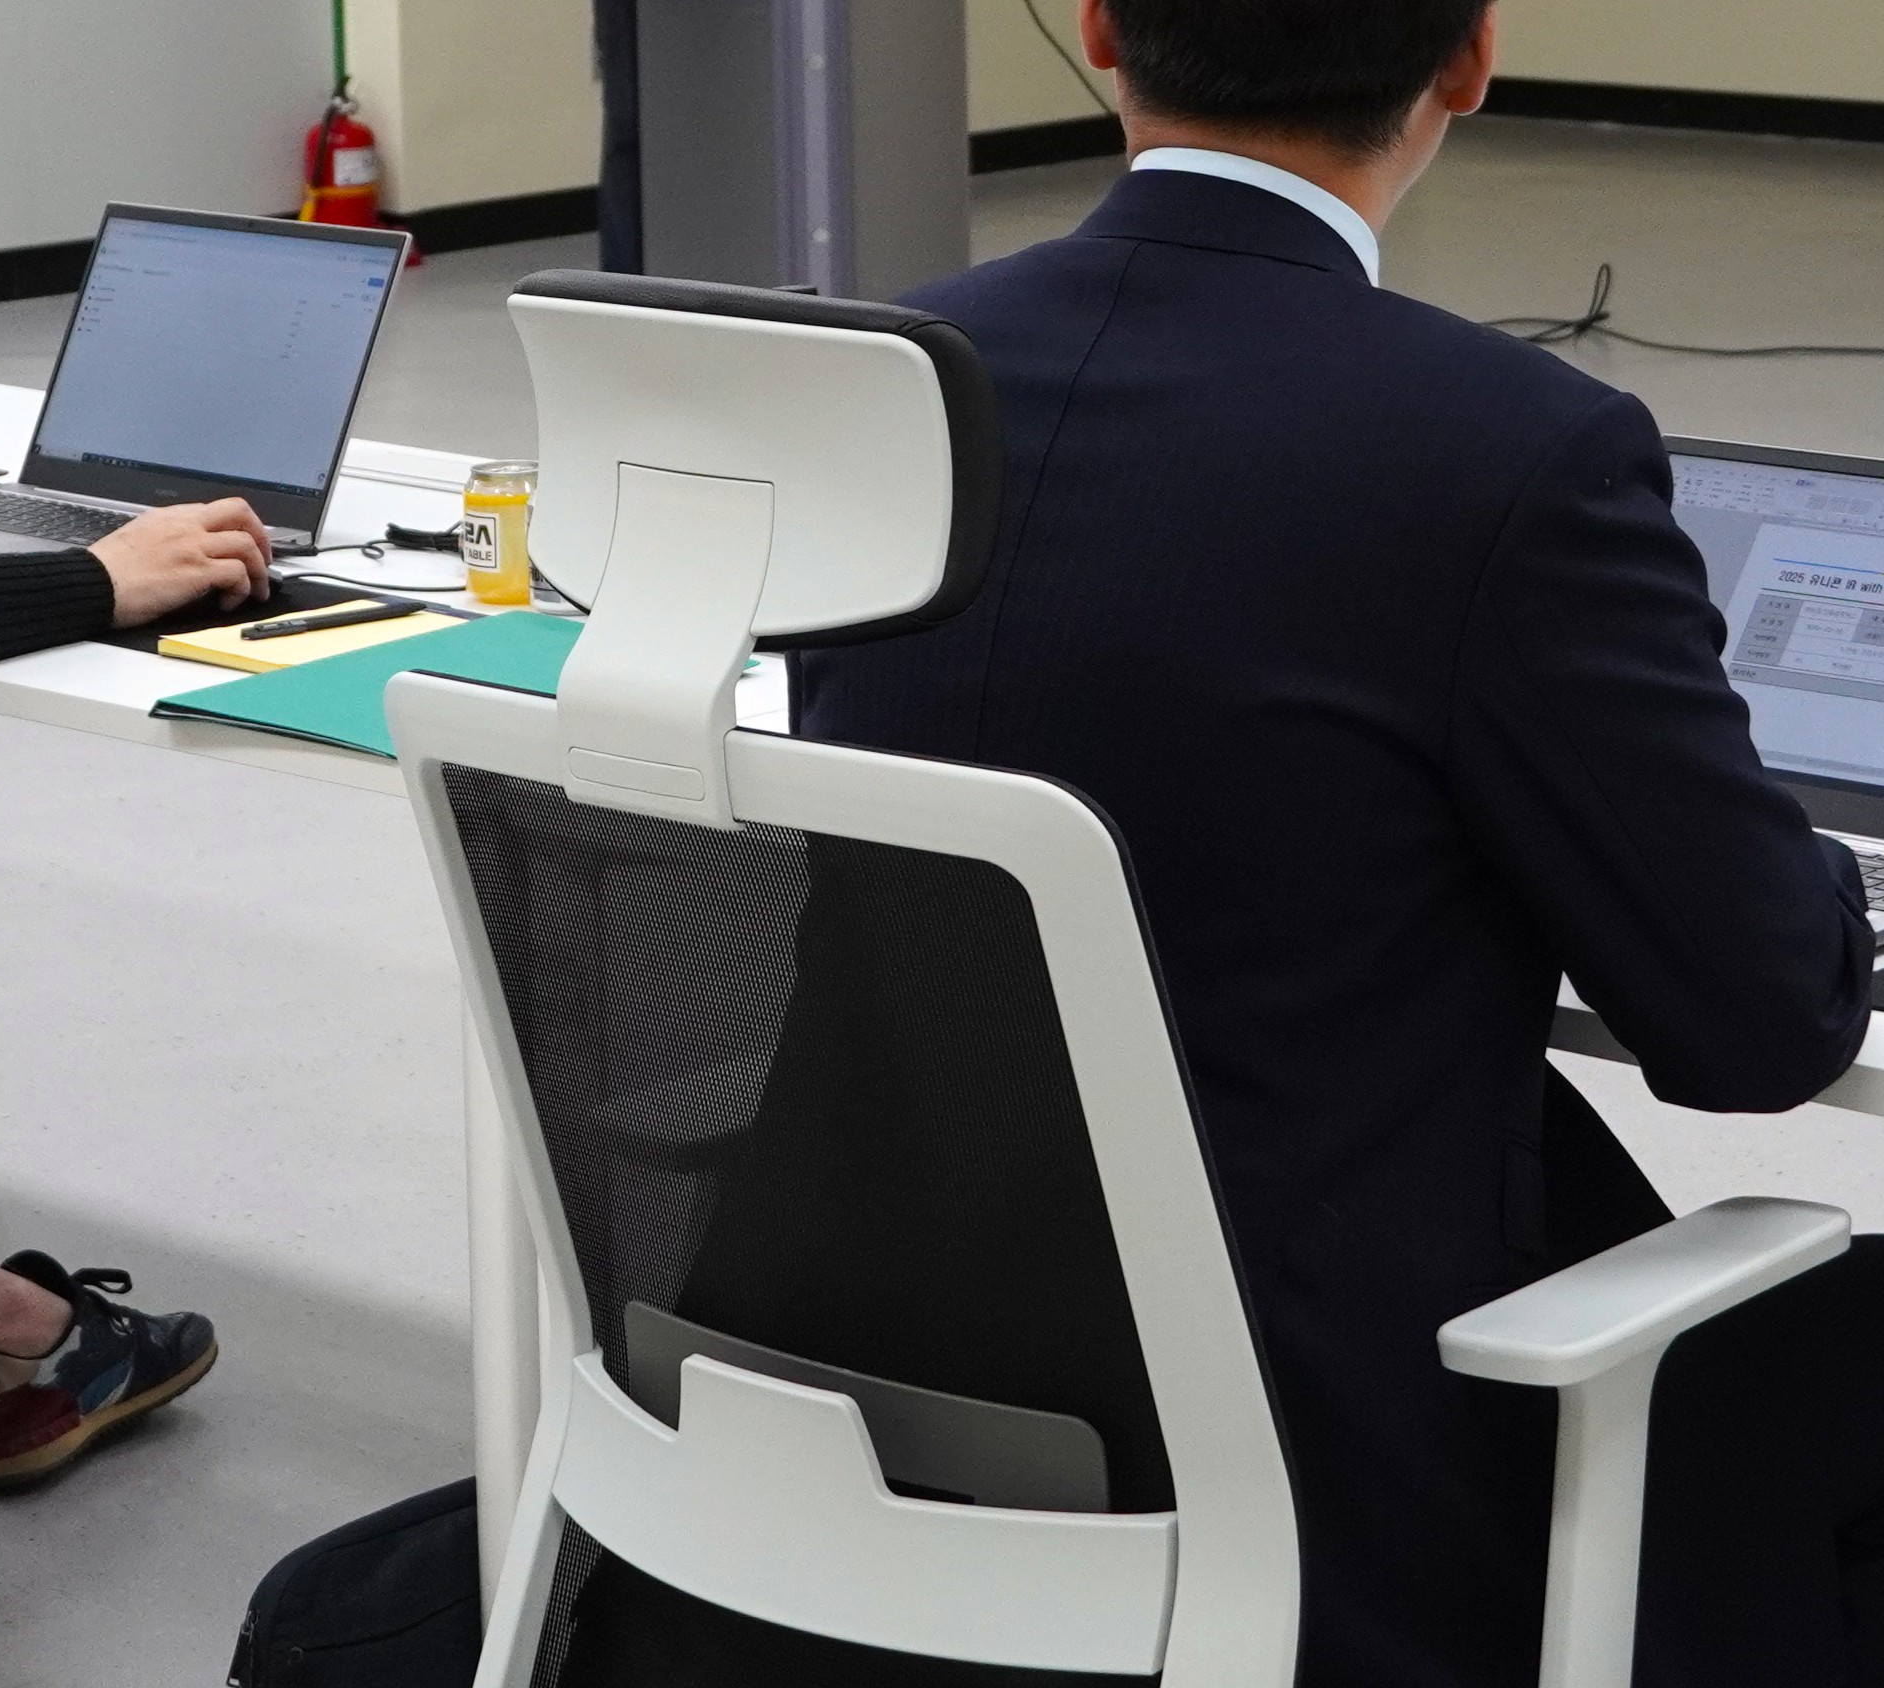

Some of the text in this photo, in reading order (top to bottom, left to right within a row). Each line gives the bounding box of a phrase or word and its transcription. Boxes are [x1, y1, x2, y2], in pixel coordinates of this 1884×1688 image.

[1778, 570, 1806, 584] 2025
[1809, 573, 1842, 589] 유니콘
[1845, 579, 1858, 591] IR
[1860, 581, 1883, 594] with
